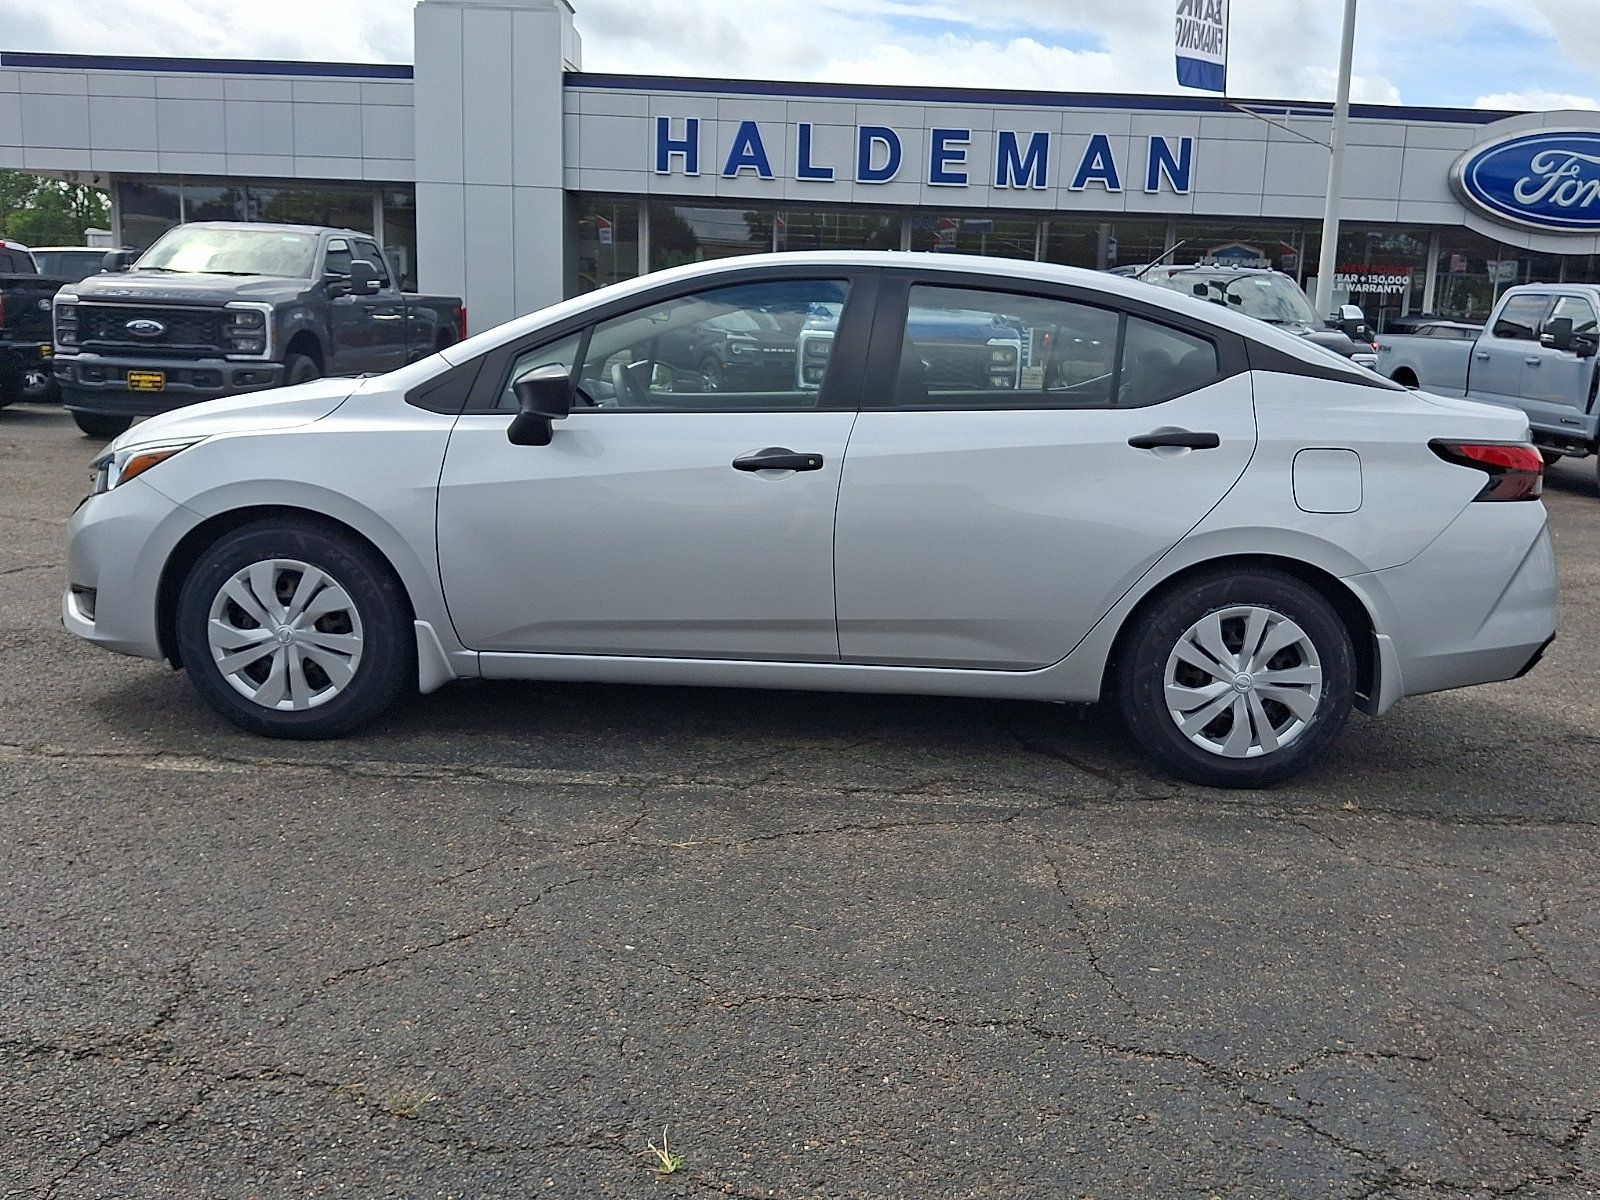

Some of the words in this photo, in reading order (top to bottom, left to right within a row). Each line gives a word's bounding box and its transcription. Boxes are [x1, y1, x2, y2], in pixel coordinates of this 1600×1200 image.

[654, 116, 1194, 194] HALDEMAN
[1513, 149, 1600, 208] For
[1346, 283, 1406, 294] WARRANTY
[1368, 275, 1410, 286] 150,000
